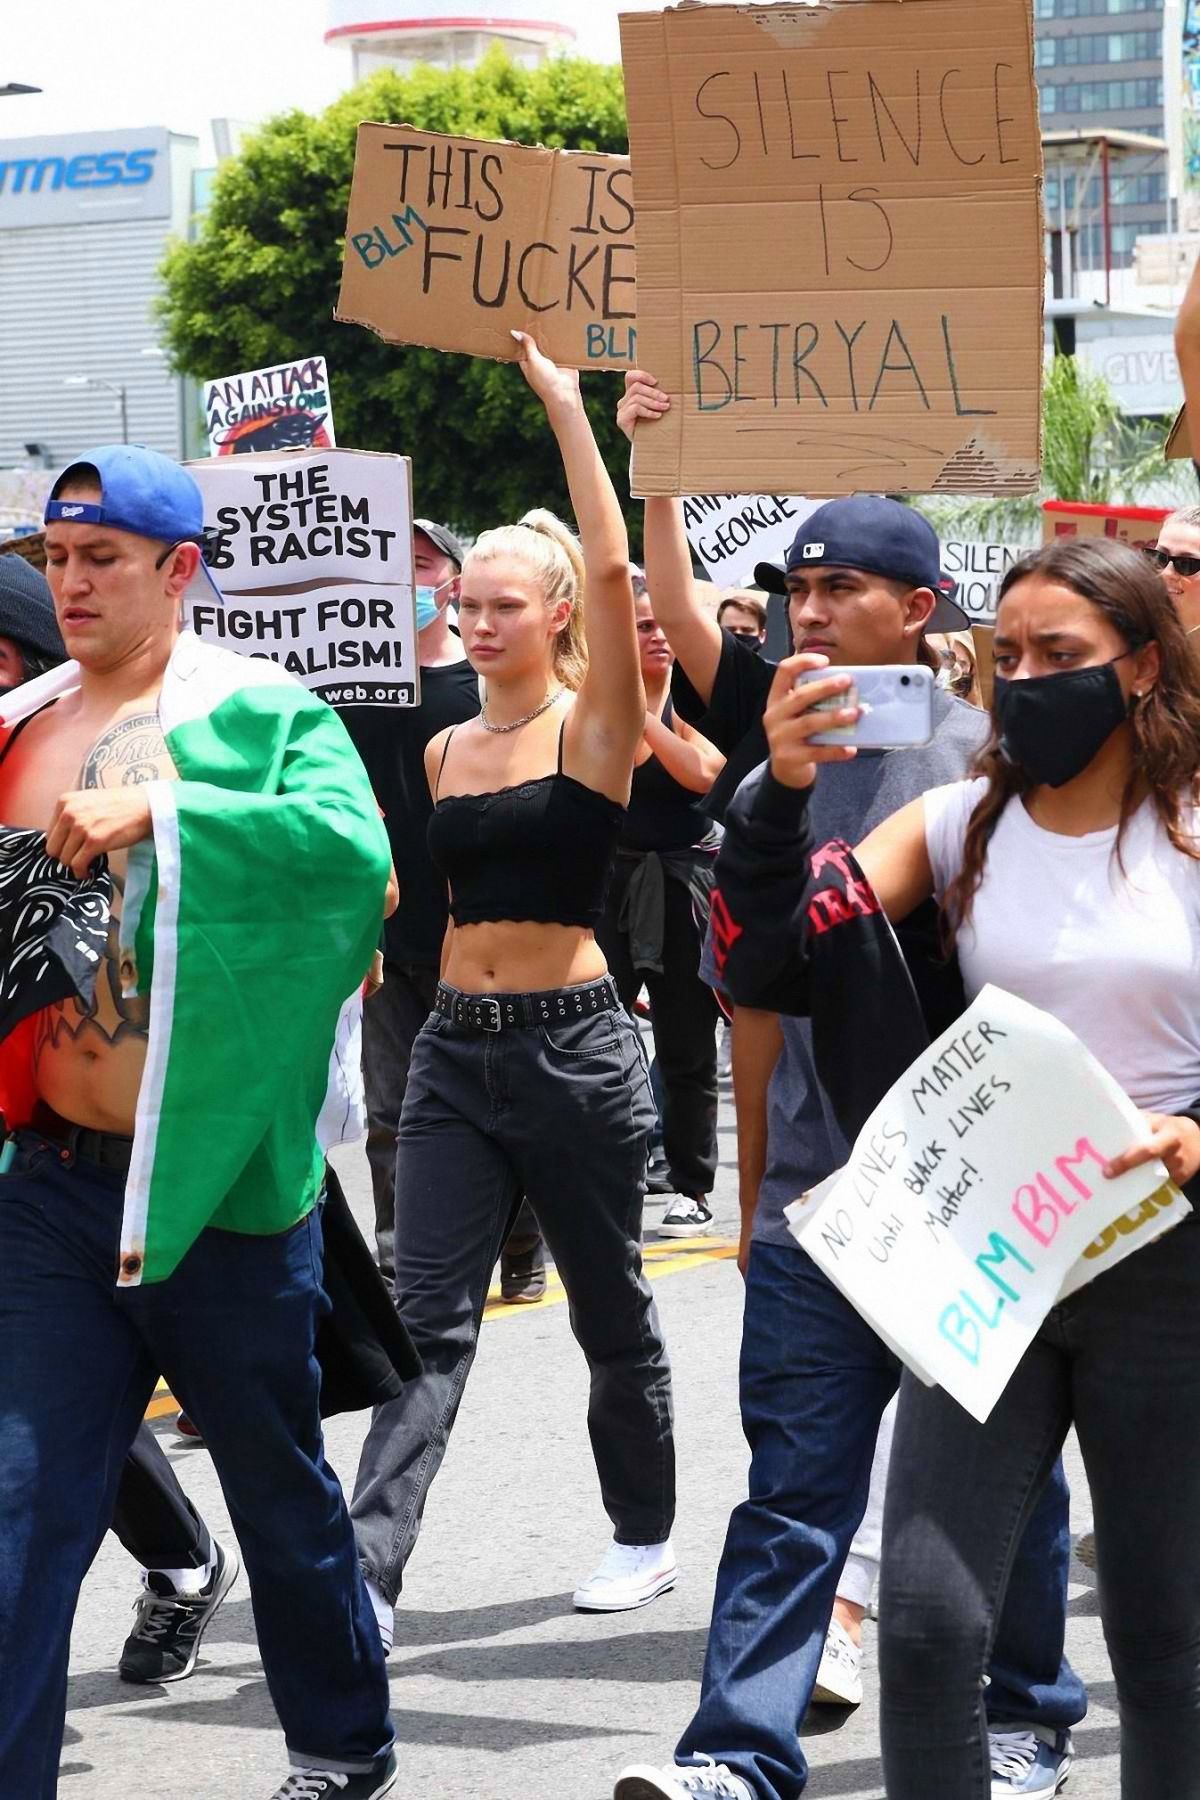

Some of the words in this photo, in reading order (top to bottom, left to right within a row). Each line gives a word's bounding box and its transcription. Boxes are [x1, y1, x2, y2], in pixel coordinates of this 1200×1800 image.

[696, 62, 1019, 170] SILENCE
[383, 143, 505, 221] THIS
[570, 165, 635, 235] IS
[351, 204, 427, 269] BLM
[818, 183, 893, 276] IS
[207, 378, 245, 411] AN
[251, 359, 325, 401] ATTACK
[693, 314, 997, 417] BETRYAL
[208, 394, 294, 435] AGAINST
[295, 389, 327, 412] ONE
[216, 494, 370, 536] SYSTEM
[253, 464, 330, 502] THE
[250, 525, 397, 567] RACIST
[698, 496, 798, 564] GEORGE
[192, 606, 307, 640] FIGHT
[317, 599, 396, 632] FOR
[821, 1208, 854, 1261] NO
[853, 1121, 908, 1208] LIVES
[911, 1020, 1007, 1116] MATTER
[867, 1213, 905, 1264] Until
[948, 1074, 1012, 1139] LIVES
[924, 1157, 984, 1245] Matter!
[938, 1231, 1036, 1367] BLM
[1012, 1136, 1112, 1248] BLM
